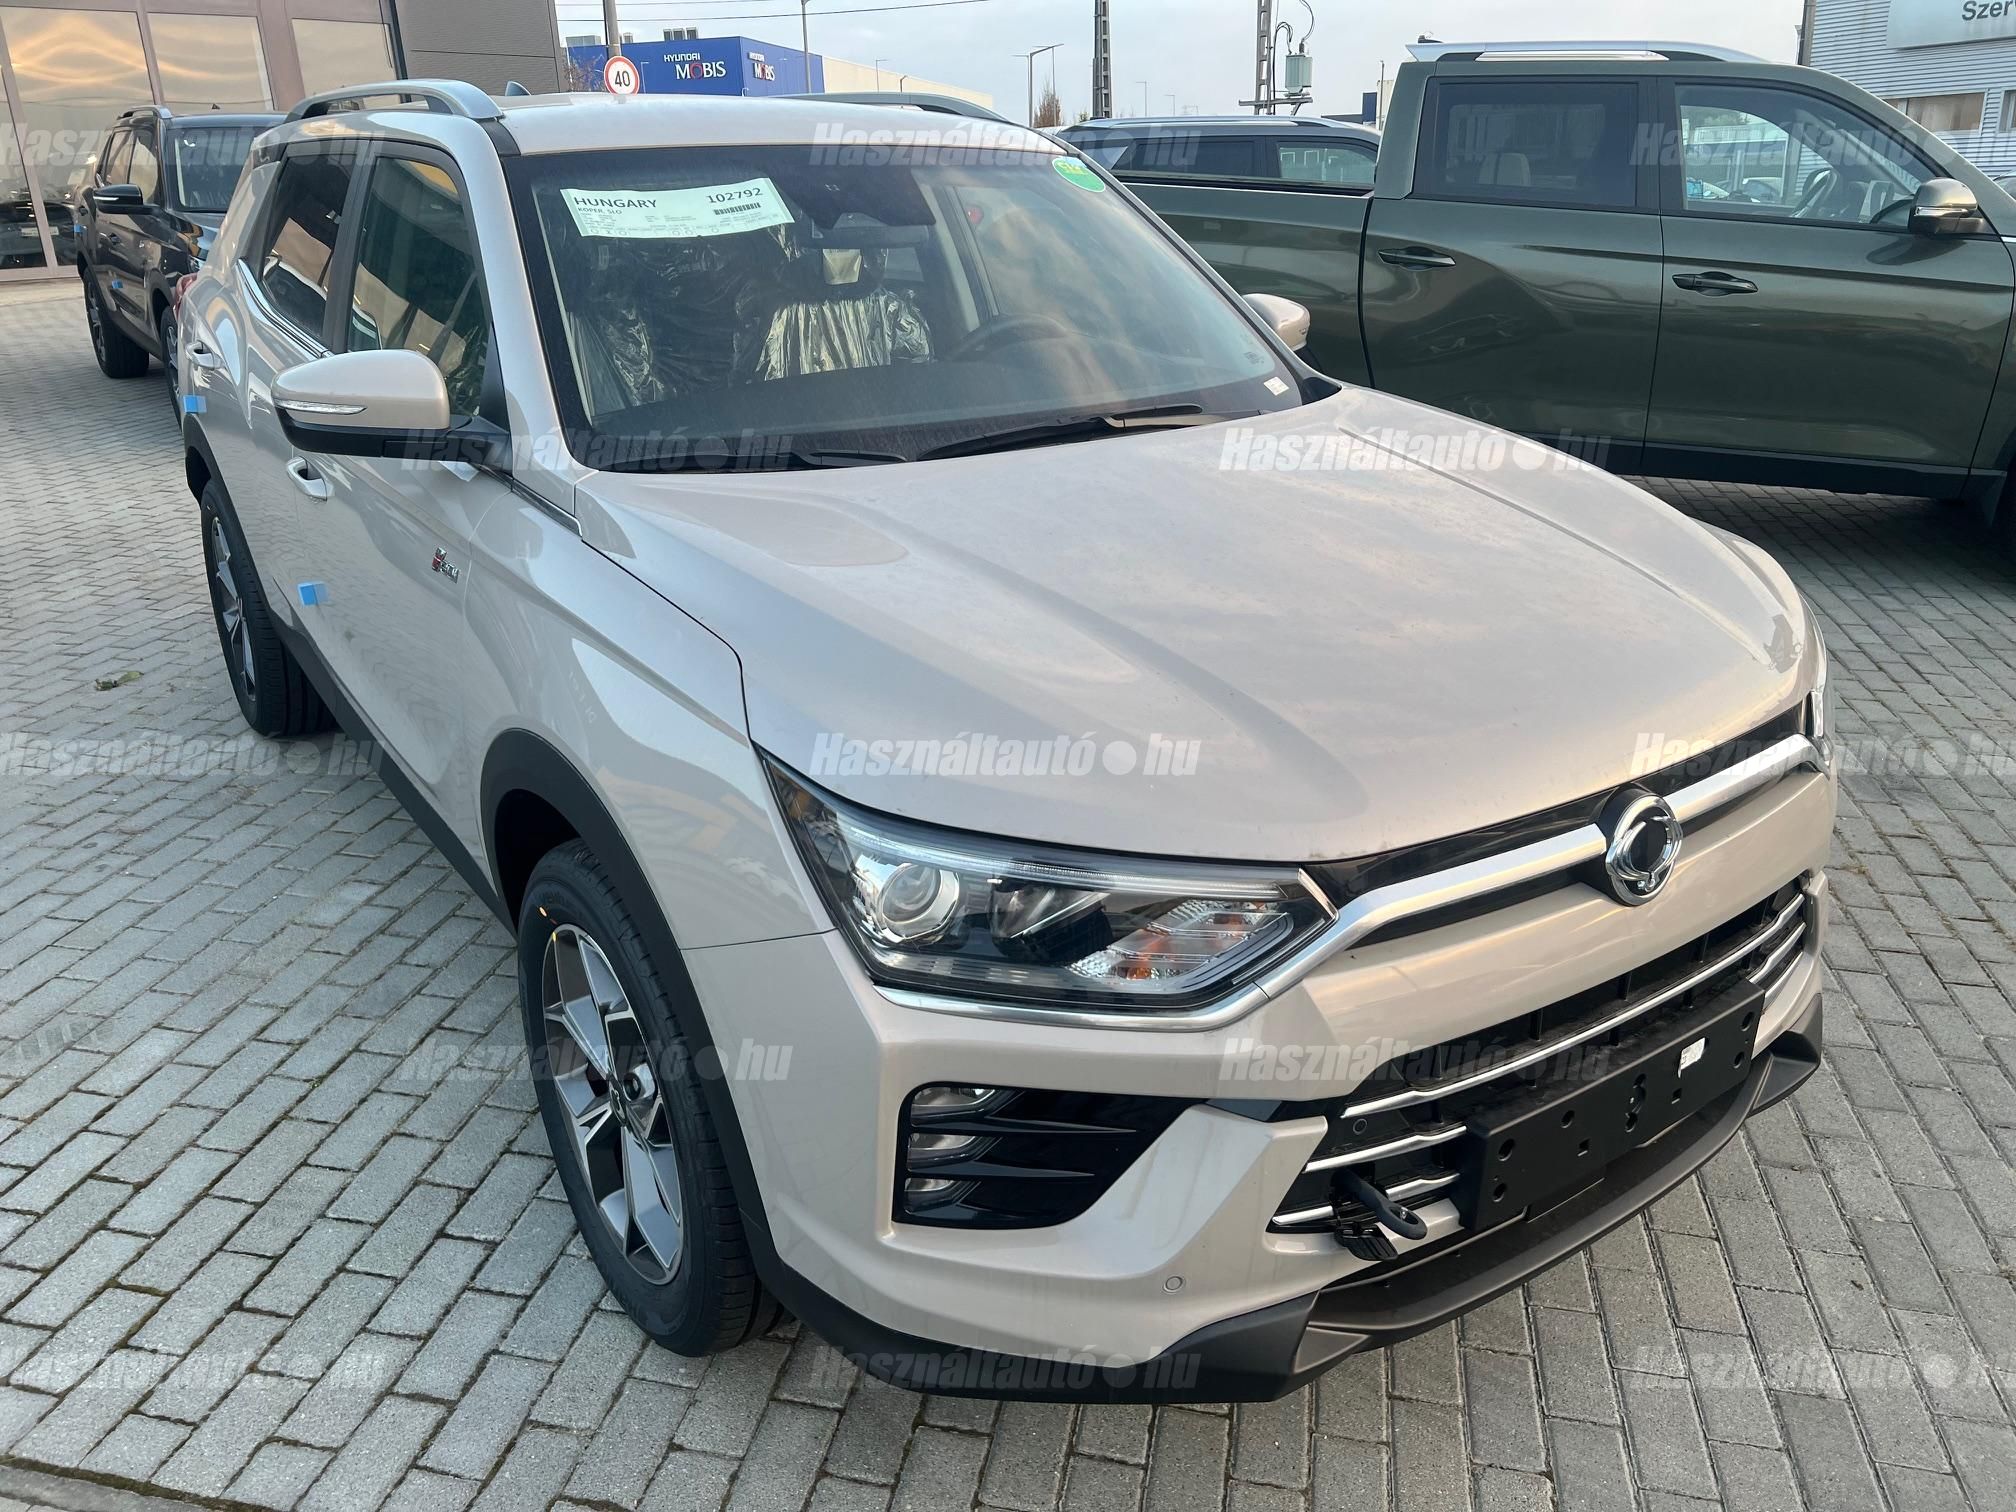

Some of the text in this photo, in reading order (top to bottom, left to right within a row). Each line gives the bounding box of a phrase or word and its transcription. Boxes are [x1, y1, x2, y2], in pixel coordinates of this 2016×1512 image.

[1962, 0, 2016, 21] Szer
[663, 53, 701, 62] HYUNDAI
[615, 70, 631, 87] 40
[675, 61, 727, 80] MOBIS
[573, 196, 657, 209] HUNGARY
[706, 187, 763, 203] 102792
